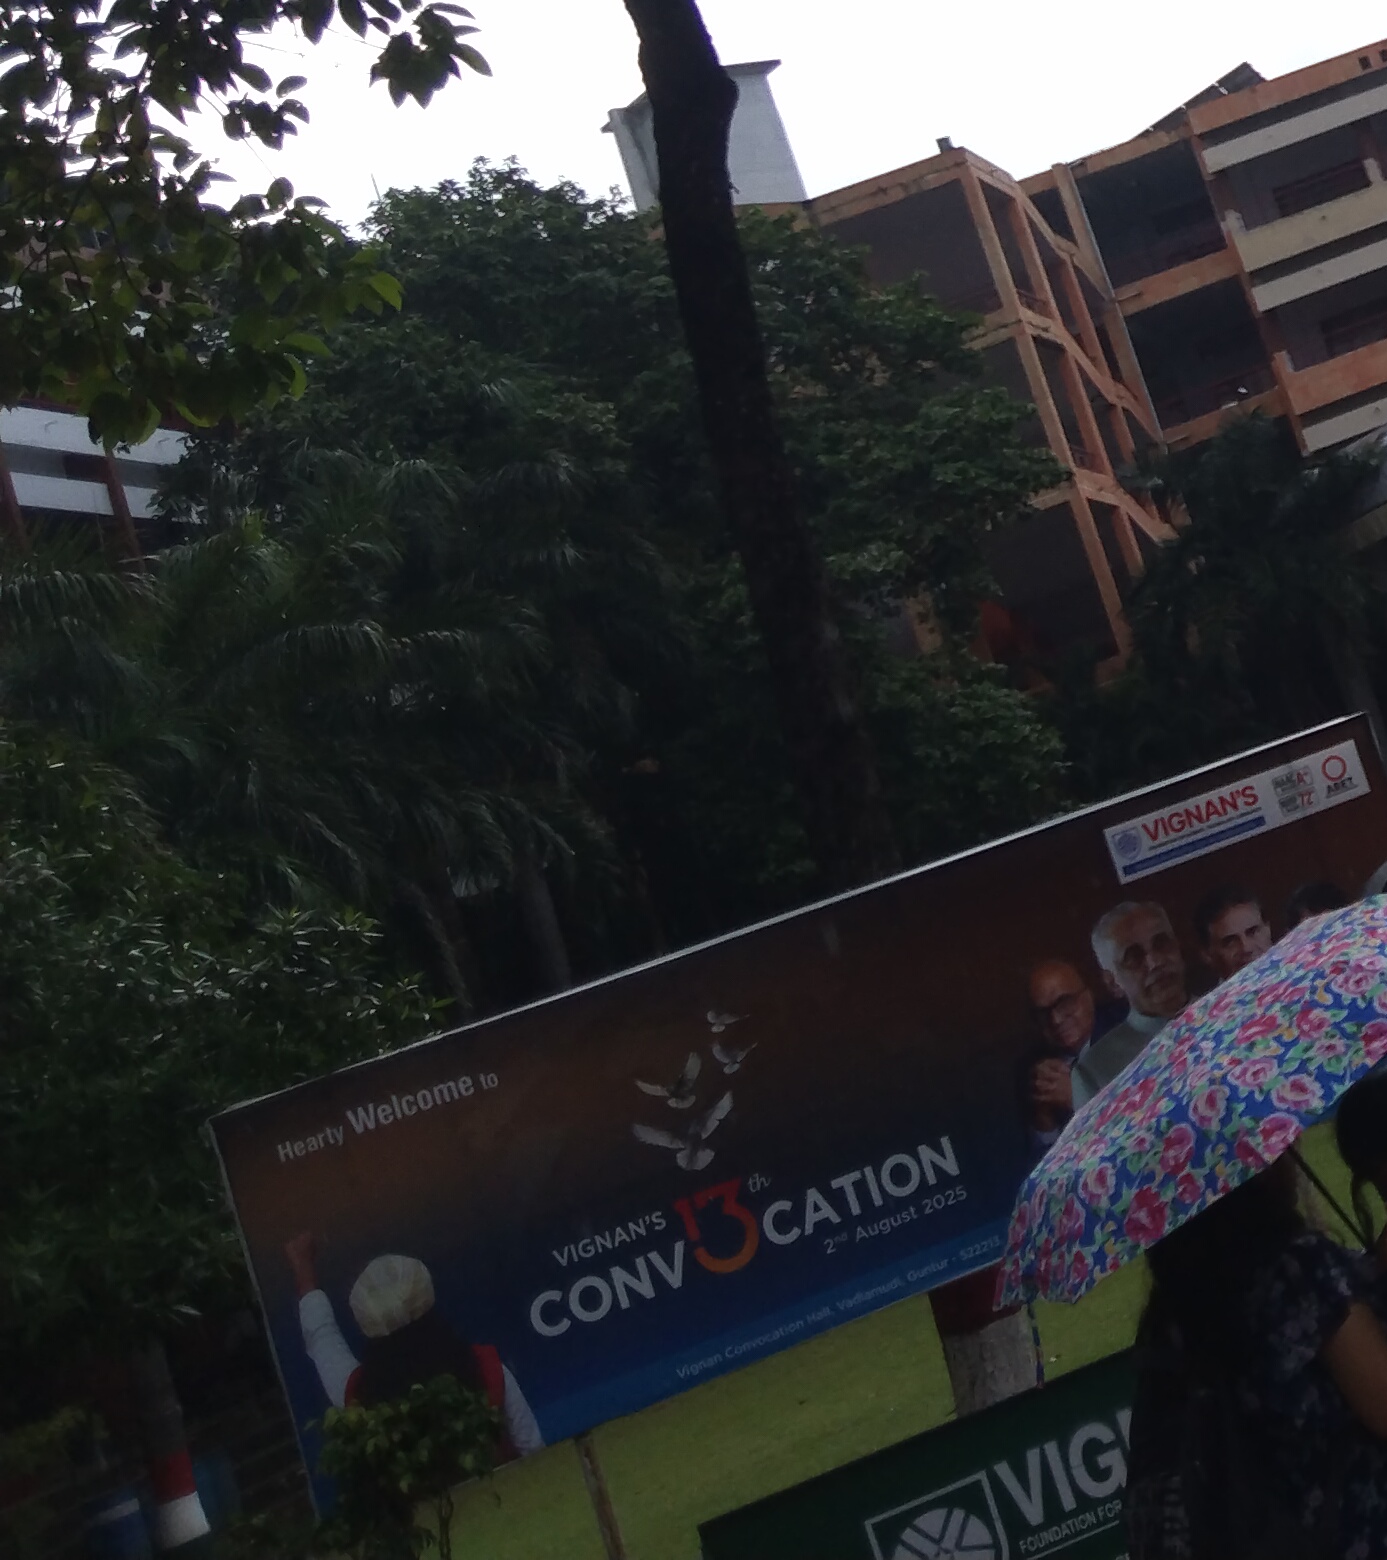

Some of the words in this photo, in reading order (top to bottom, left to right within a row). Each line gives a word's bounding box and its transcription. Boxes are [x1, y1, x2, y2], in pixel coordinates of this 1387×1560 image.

[1141, 785, 1260, 842] VIGNAN'S
[277, 1125, 344, 1163] Hearty
[346, 1073, 475, 1135] Welcome
[478, 1071, 499, 1090] to
[552, 1209, 667, 1268] VIGNAN'S
[854, 1207, 918, 1244] August
[922, 1185, 968, 1216] 2025
[676, 1350, 724, 1380] Vignan
[724, 1317, 804, 1359] Convocation
[907, 1257, 949, 1282] Guntur
[1018, 1510, 1098, 1555] FOUNDATION
